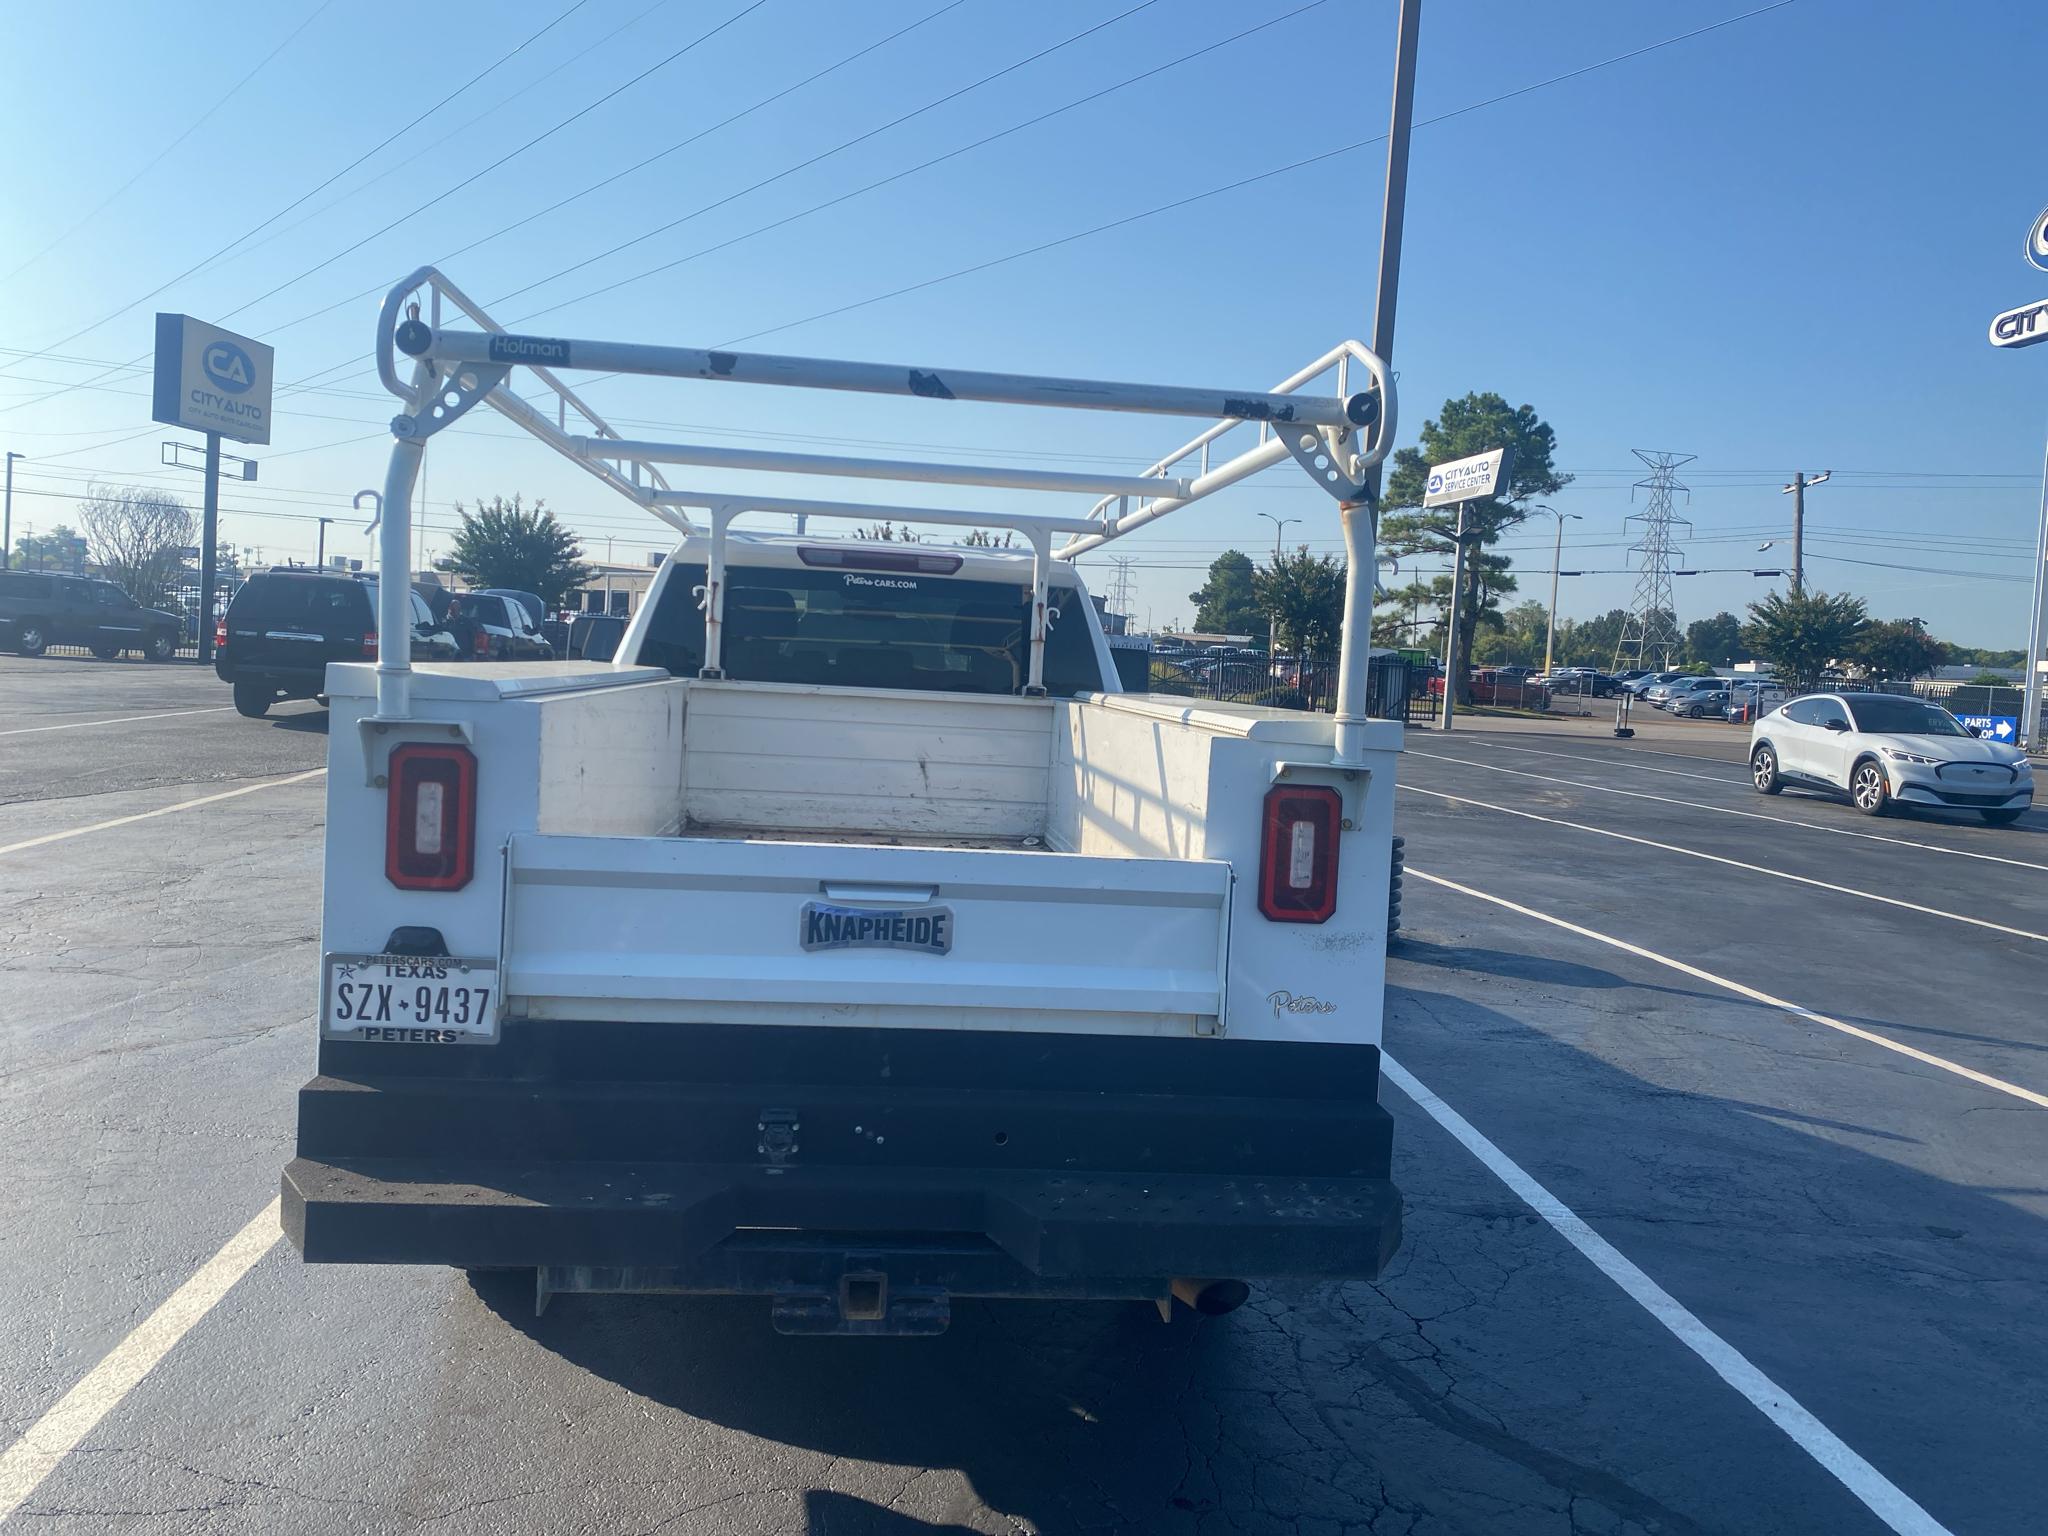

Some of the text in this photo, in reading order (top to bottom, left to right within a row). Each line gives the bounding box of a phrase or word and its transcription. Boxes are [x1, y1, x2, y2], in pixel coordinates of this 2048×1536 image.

[495, 336, 563, 357] Holman
[1444, 473, 1491, 493] SERVICE CENTER
[843, 574, 917, 589] Peters CARS.COM
[1964, 717, 1992, 728] PARTS
[808, 910, 946, 948] KNAPHEIDE
[385, 965, 448, 980] TEXAS
[1266, 990, 1337, 1020] Peters
[365, 1026, 457, 1043] PETERS
